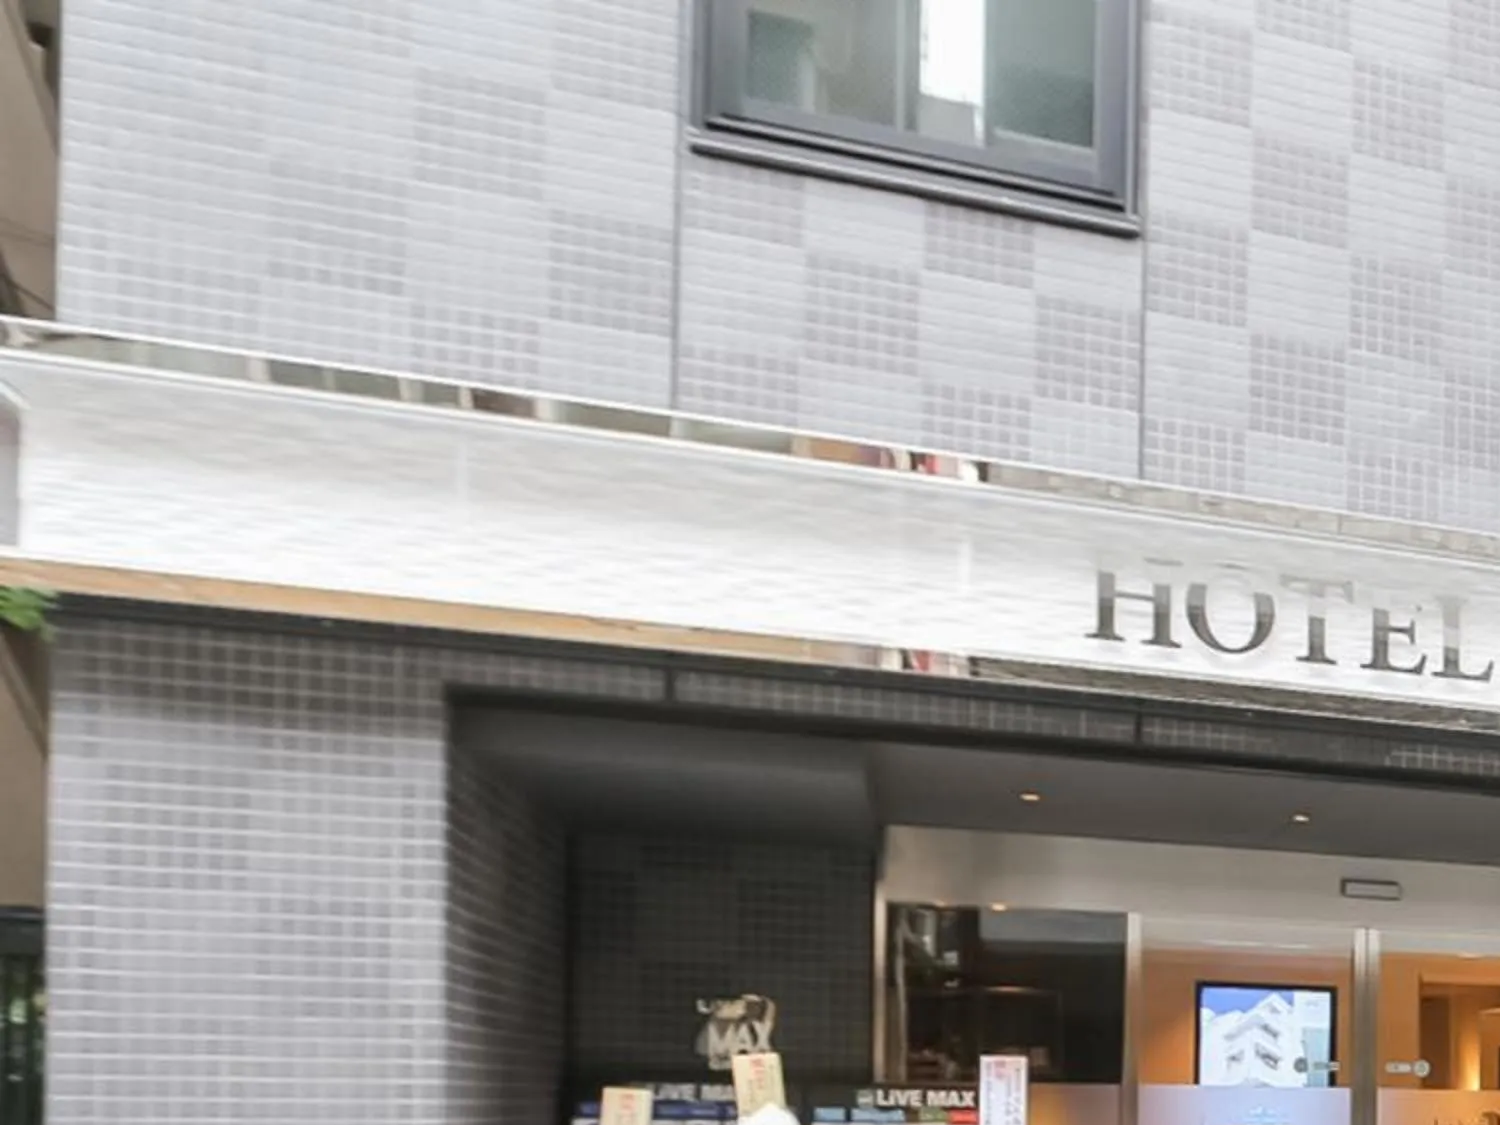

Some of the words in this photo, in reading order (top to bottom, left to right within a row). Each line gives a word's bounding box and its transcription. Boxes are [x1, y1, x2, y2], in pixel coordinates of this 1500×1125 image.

[1084, 557, 1495, 682] HOTEL
[876, 1089, 923, 1107] LIVE
[926, 1090, 977, 1108] MAX
